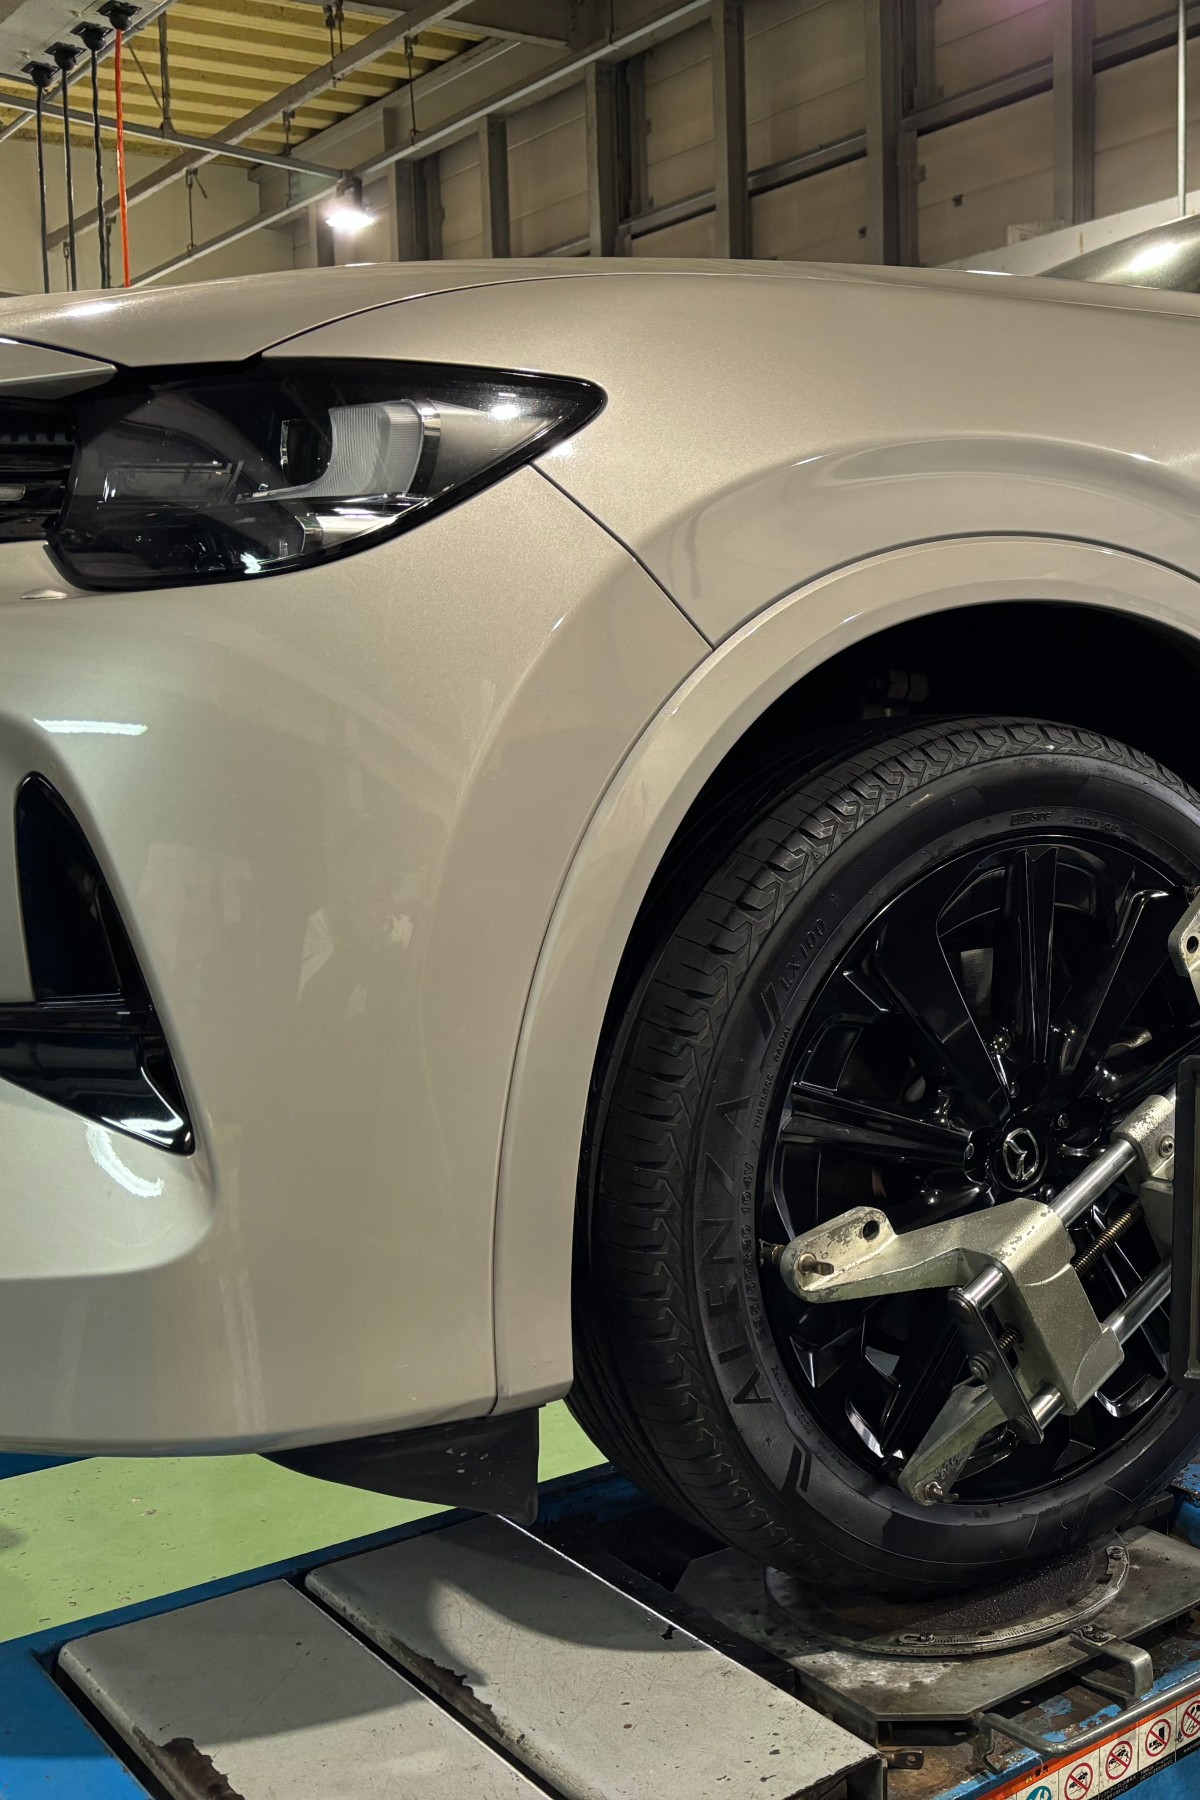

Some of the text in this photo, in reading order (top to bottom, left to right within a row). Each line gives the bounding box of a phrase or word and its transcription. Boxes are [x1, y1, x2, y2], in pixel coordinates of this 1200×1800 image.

[1010, 811, 1052, 826] OUTSIDE
[1073, 815, 1121, 833] EXTRA LOAD
[779, 918, 826, 992] LX100
[753, 1025, 792, 1130] TUBELESS RADIAL
[698, 1093, 773, 1405] ALENZA
